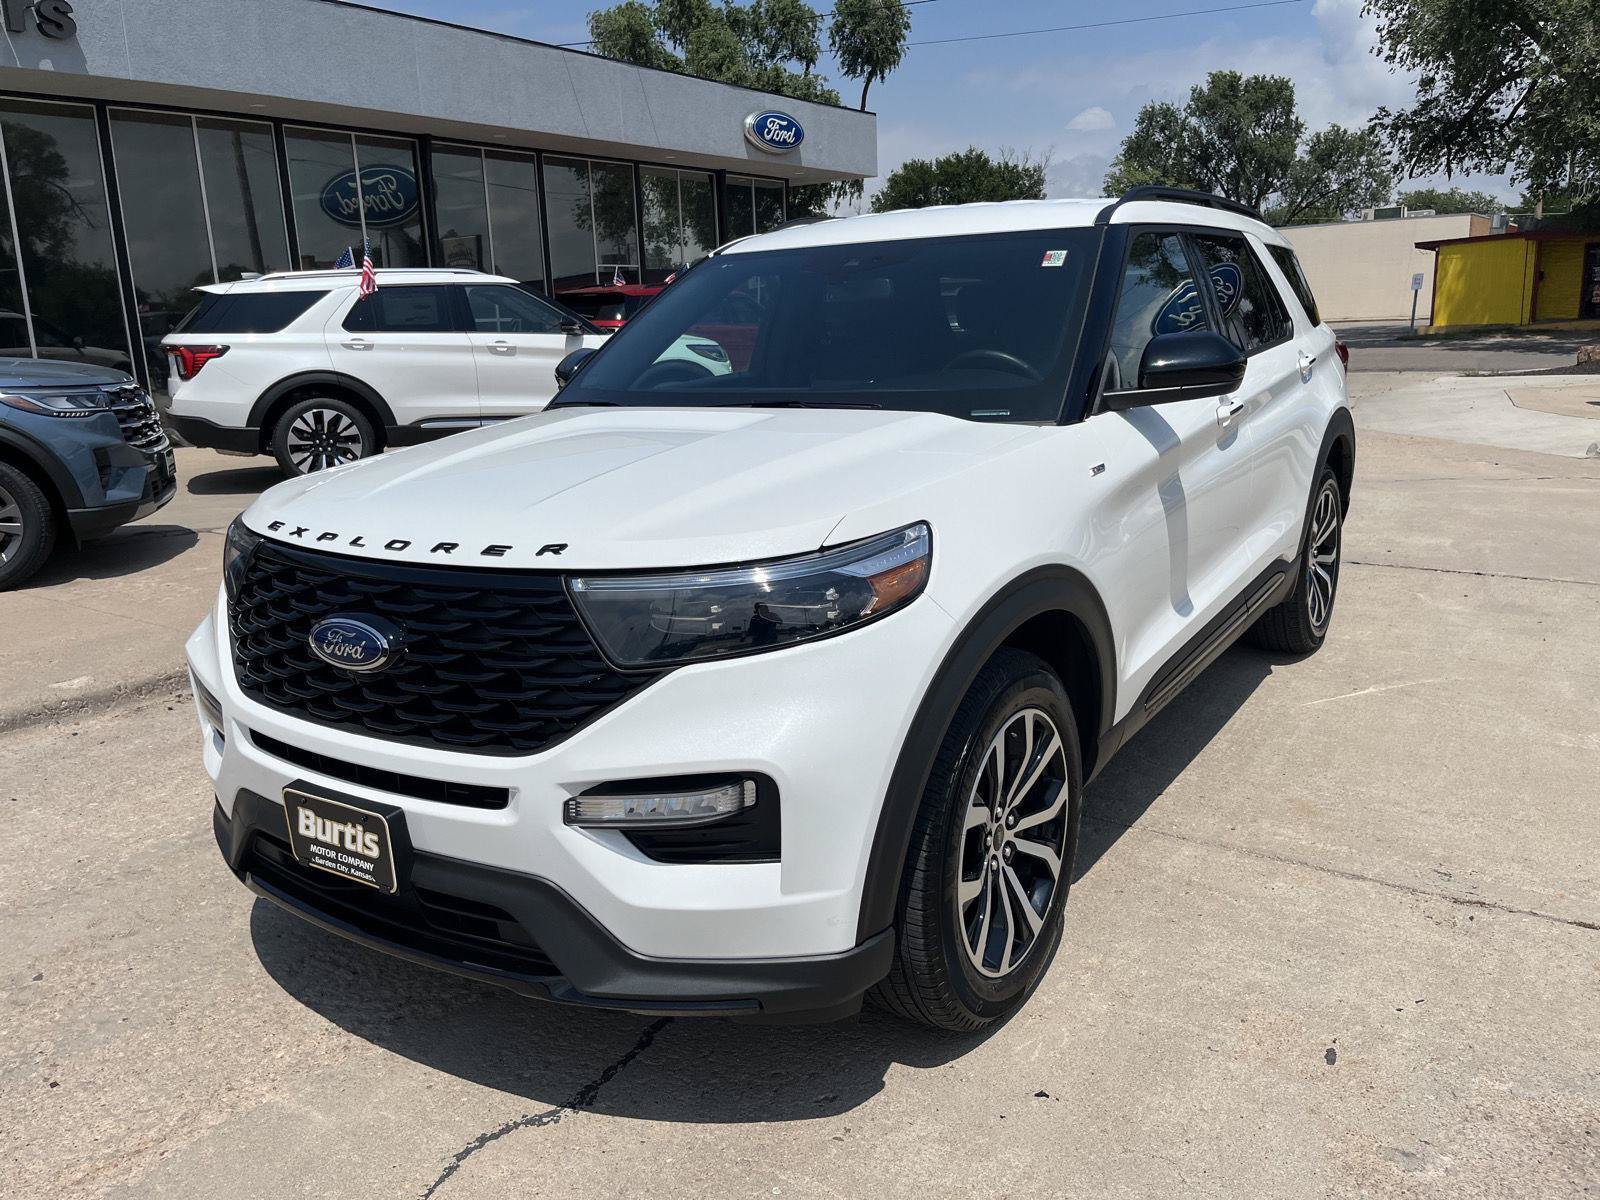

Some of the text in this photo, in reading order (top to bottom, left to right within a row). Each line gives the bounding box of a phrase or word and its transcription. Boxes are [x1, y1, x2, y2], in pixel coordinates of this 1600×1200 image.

[764, 118, 795, 144] Ford
[267, 520, 568, 557] EXPLORER
[323, 628, 366, 659] Ford
[297, 806, 380, 859] Burtis
[310, 844, 375, 872] MOTOR COMPANY
[315, 857, 336, 869] Garden
[350, 868, 372, 881] Kansas
